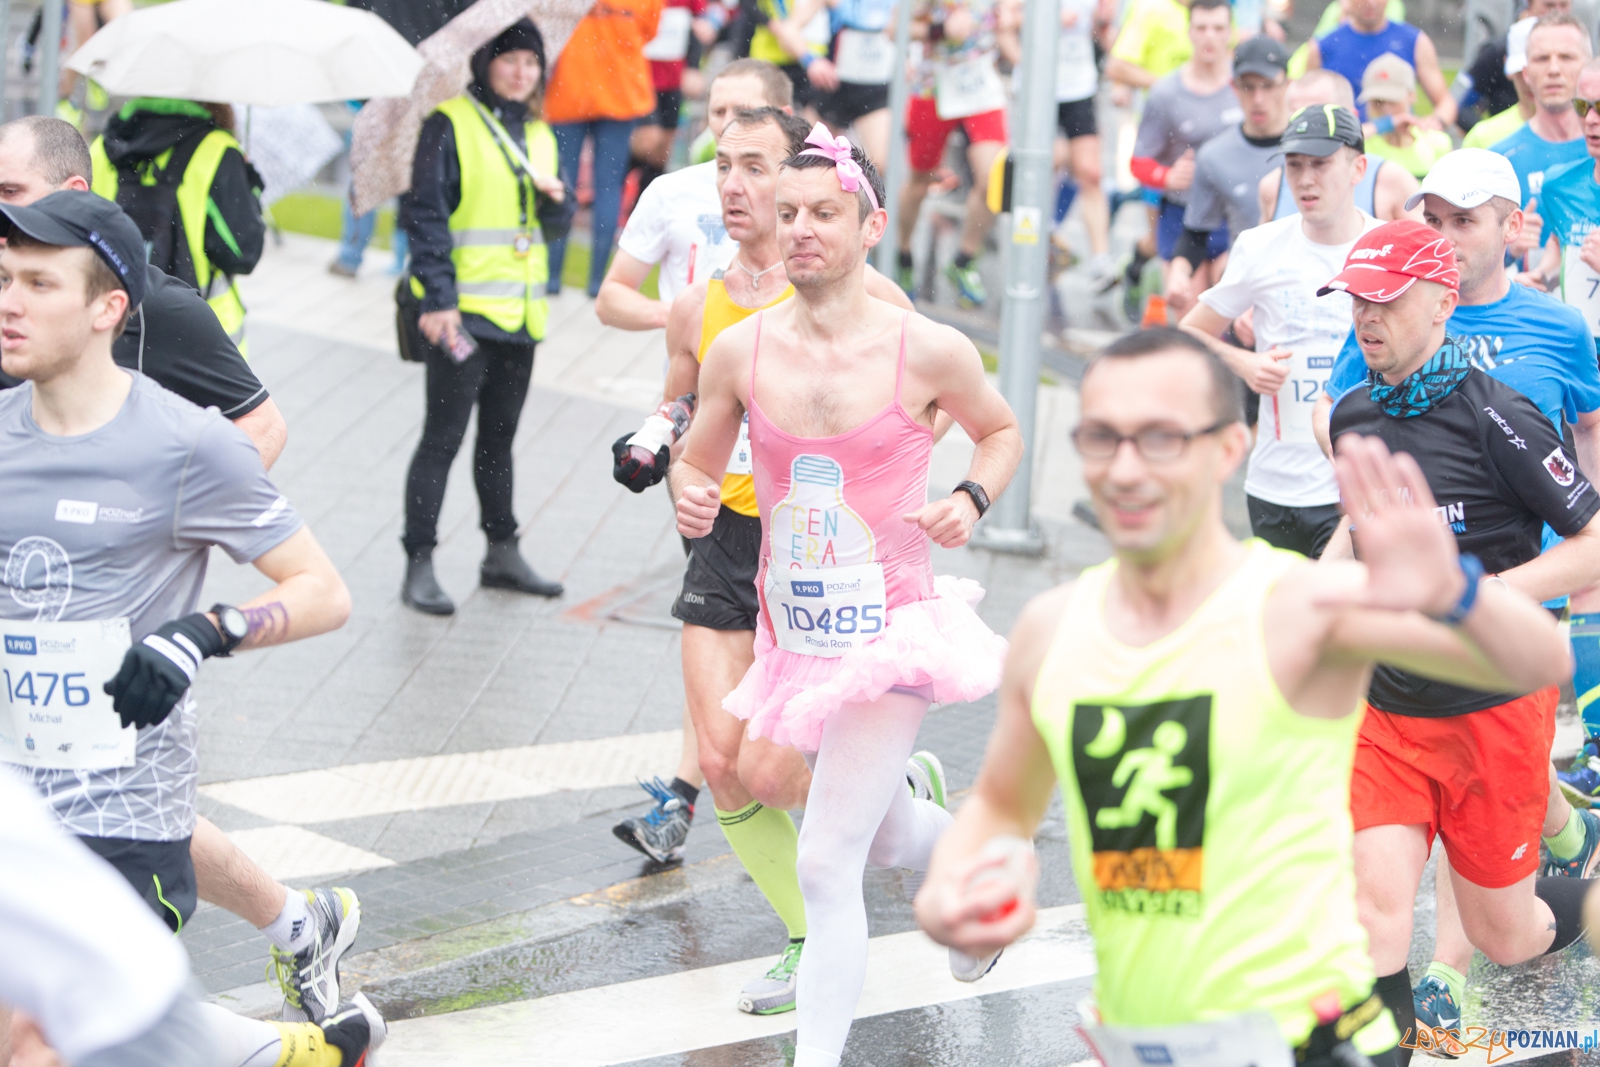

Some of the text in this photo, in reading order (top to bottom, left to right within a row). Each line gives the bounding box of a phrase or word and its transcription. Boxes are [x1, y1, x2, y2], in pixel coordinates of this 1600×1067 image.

[792, 506, 838, 537] GEN
[791, 534, 836, 566] ERA
[795, 585, 819, 594] 9.PKO
[781, 602, 882, 635] 10485
[7, 639, 32, 651] 9.PKO
[830, 639, 852, 648] Rom
[3, 668, 90, 707] 1476
